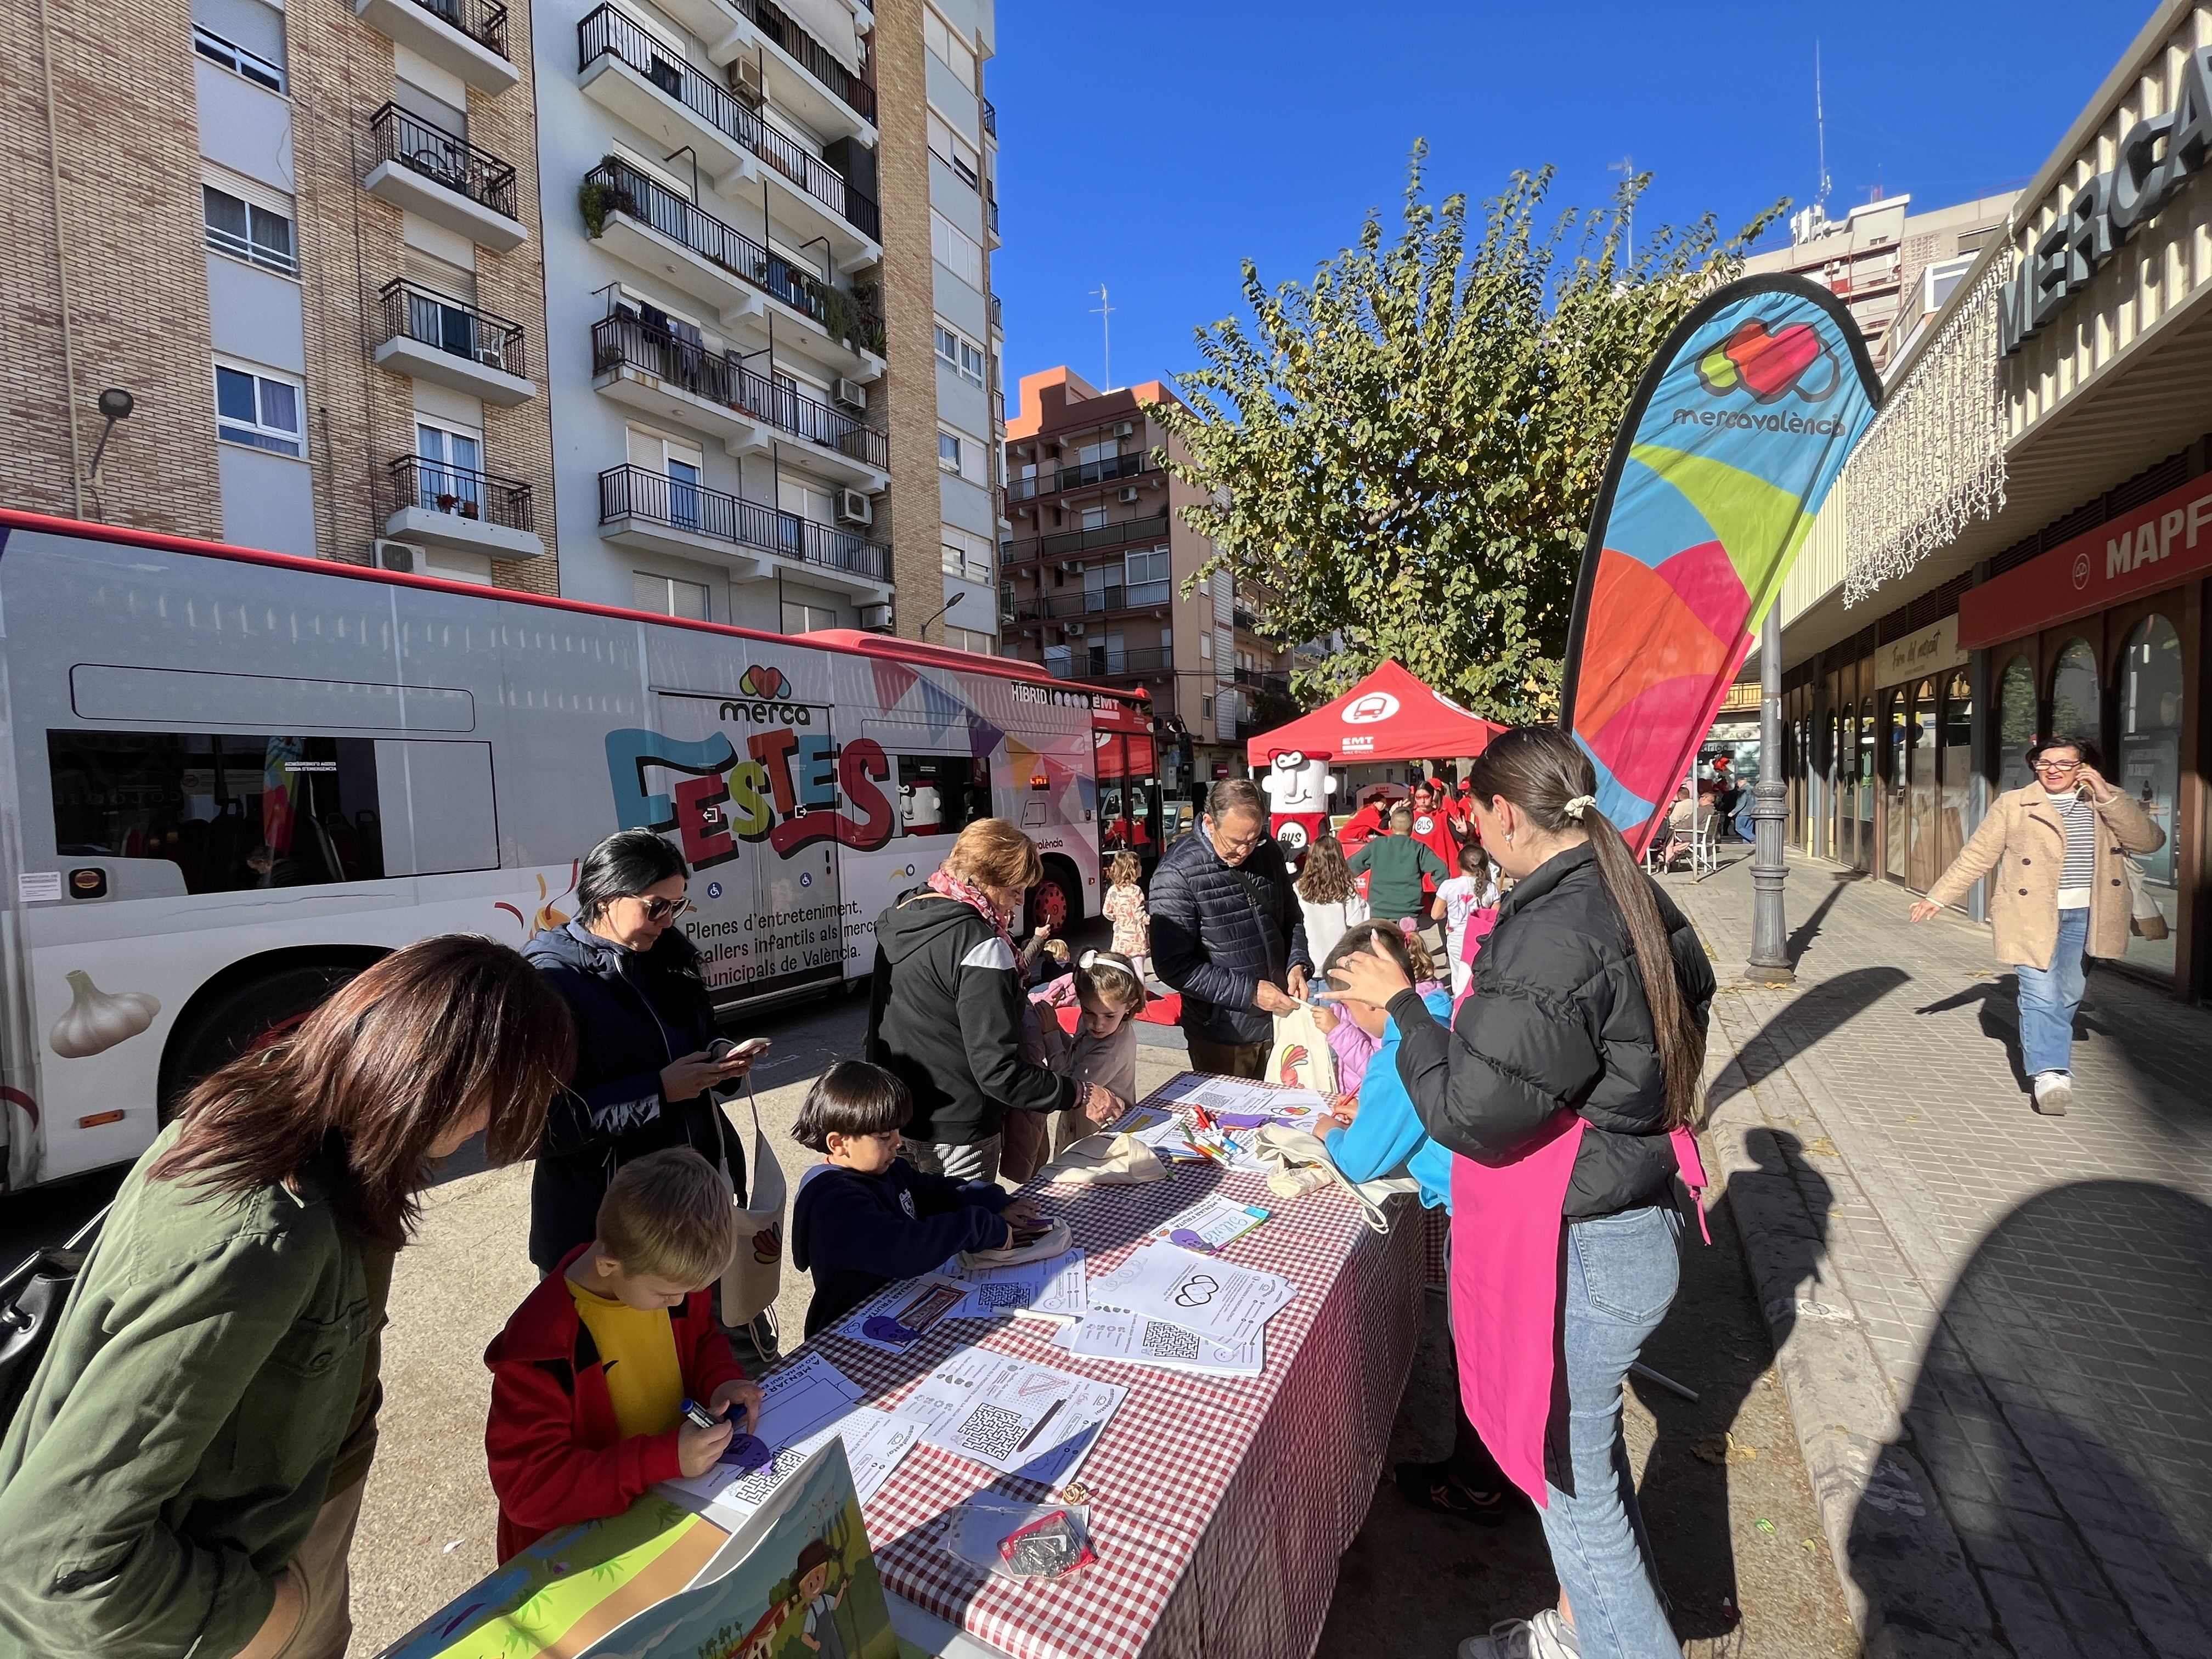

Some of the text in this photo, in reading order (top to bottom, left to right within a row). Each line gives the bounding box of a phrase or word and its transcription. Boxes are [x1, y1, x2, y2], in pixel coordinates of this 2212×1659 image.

[1673, 408, 1846, 437] mercavalència
[1011, 682, 1047, 705] HÍBRID
[719, 702, 811, 725] merca
[1342, 736, 1374, 745] EMT
[1703, 742, 1728, 752] drigo
[606, 728, 894, 871] FESTES
[1417, 820, 1431, 830] BUS
[1281, 833, 1301, 843] BUS
[686, 920, 738, 940] Plenes
[703, 943, 749, 963] allers
[754, 928, 815, 954] infantils
[820, 924, 837, 942] als
[781, 955, 797, 973] de
[803, 945, 861, 967] València.
[1195, 1201, 1218, 1217] MENJAR
[1174, 1215, 1196, 1228] FRUITA
[891, 1276, 919, 1300] MENJAR
[865, 1299, 893, 1321] FRUITA
[805, 1355, 816, 1364] NO
[769, 1365, 812, 1392] MENJAR
[771, 1376, 783, 1385] QUI
[868, 1420, 879, 1432] SOPA
[886, 1425, 913, 1457] mercafesta!
